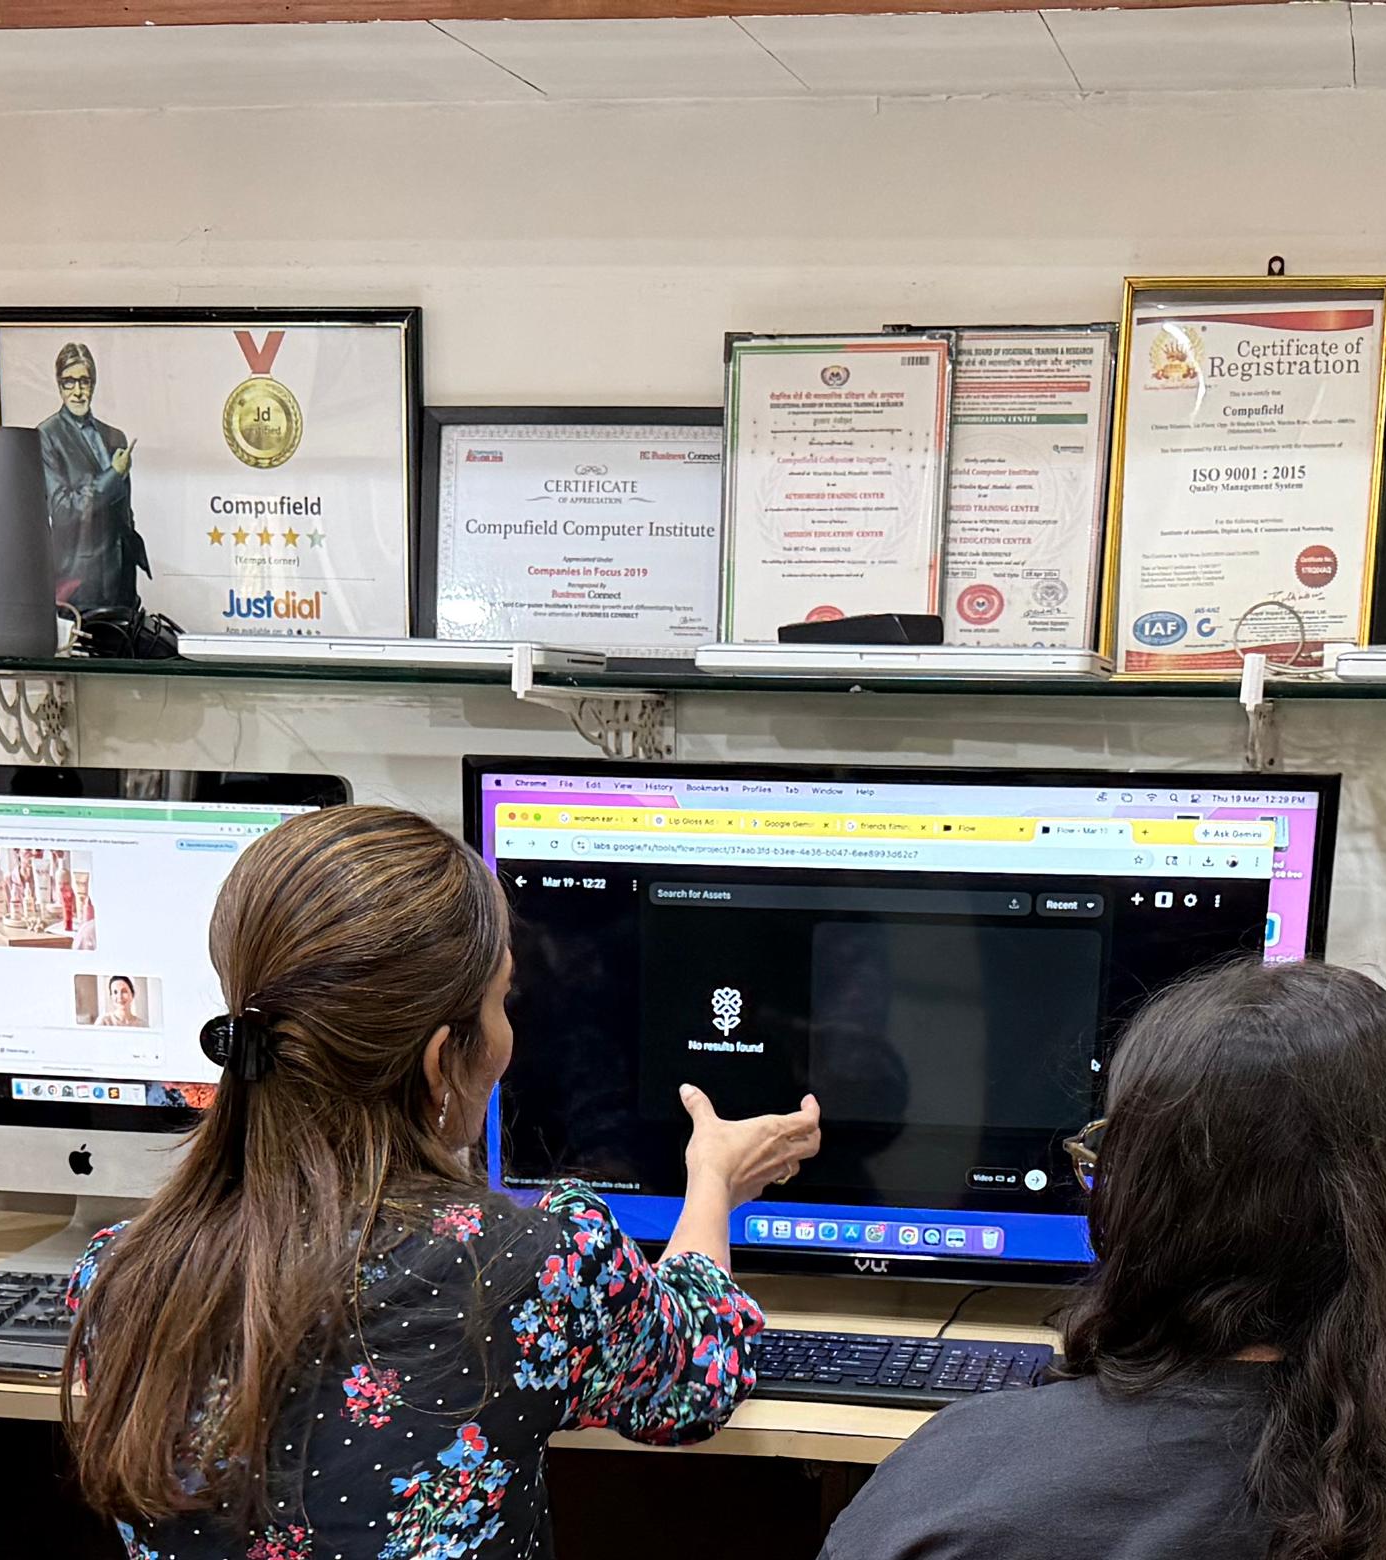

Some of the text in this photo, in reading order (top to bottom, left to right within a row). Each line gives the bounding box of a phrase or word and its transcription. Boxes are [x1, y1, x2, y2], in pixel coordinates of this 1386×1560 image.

[1237, 337, 1364, 357] Certificate of
[1208, 356, 1360, 382] Registration
[253, 407, 270, 422] Jd
[1223, 405, 1283, 418] Compufield
[687, 451, 720, 460] Connect
[1192, 468, 1220, 482] ISO
[1225, 467, 1256, 481] 9001
[1272, 465, 1306, 479] 2015
[544, 480, 637, 493] CERTIFICATE
[1189, 482, 1303, 493] Quality Management System
[210, 496, 321, 518] Compufield
[465, 519, 715, 541] Compufield Computer Institute
[528, 566, 647, 577] Companies in Focus 2019
[587, 591, 621, 599] Connect
[222, 589, 321, 619] Justdial
[1143, 621, 1177, 636] IAF
[515, 779, 547, 787] Chrome
[645, 783, 673, 791] History
[686, 784, 729, 792] Bookmarks
[742, 785, 772, 793] Profiles
[785, 786, 799, 794] Tab
[812, 787, 843, 795] Window
[856, 788, 875, 796] Help
[1212, 795, 1305, 804] Thu 19 Mar 12:29 PM
[765, 820, 791, 829] Google
[1214, 830, 1262, 838] Ask Gemini
[542, 877, 561, 887] Mar
[563, 877, 574, 887] 19
[583, 878, 606, 889] 12:22
[657, 889, 731, 900] Search for Assets
[1046, 901, 1078, 910] Recent
[688, 1040, 763, 1053] No results found
[973, 1174, 993, 1182] Video
